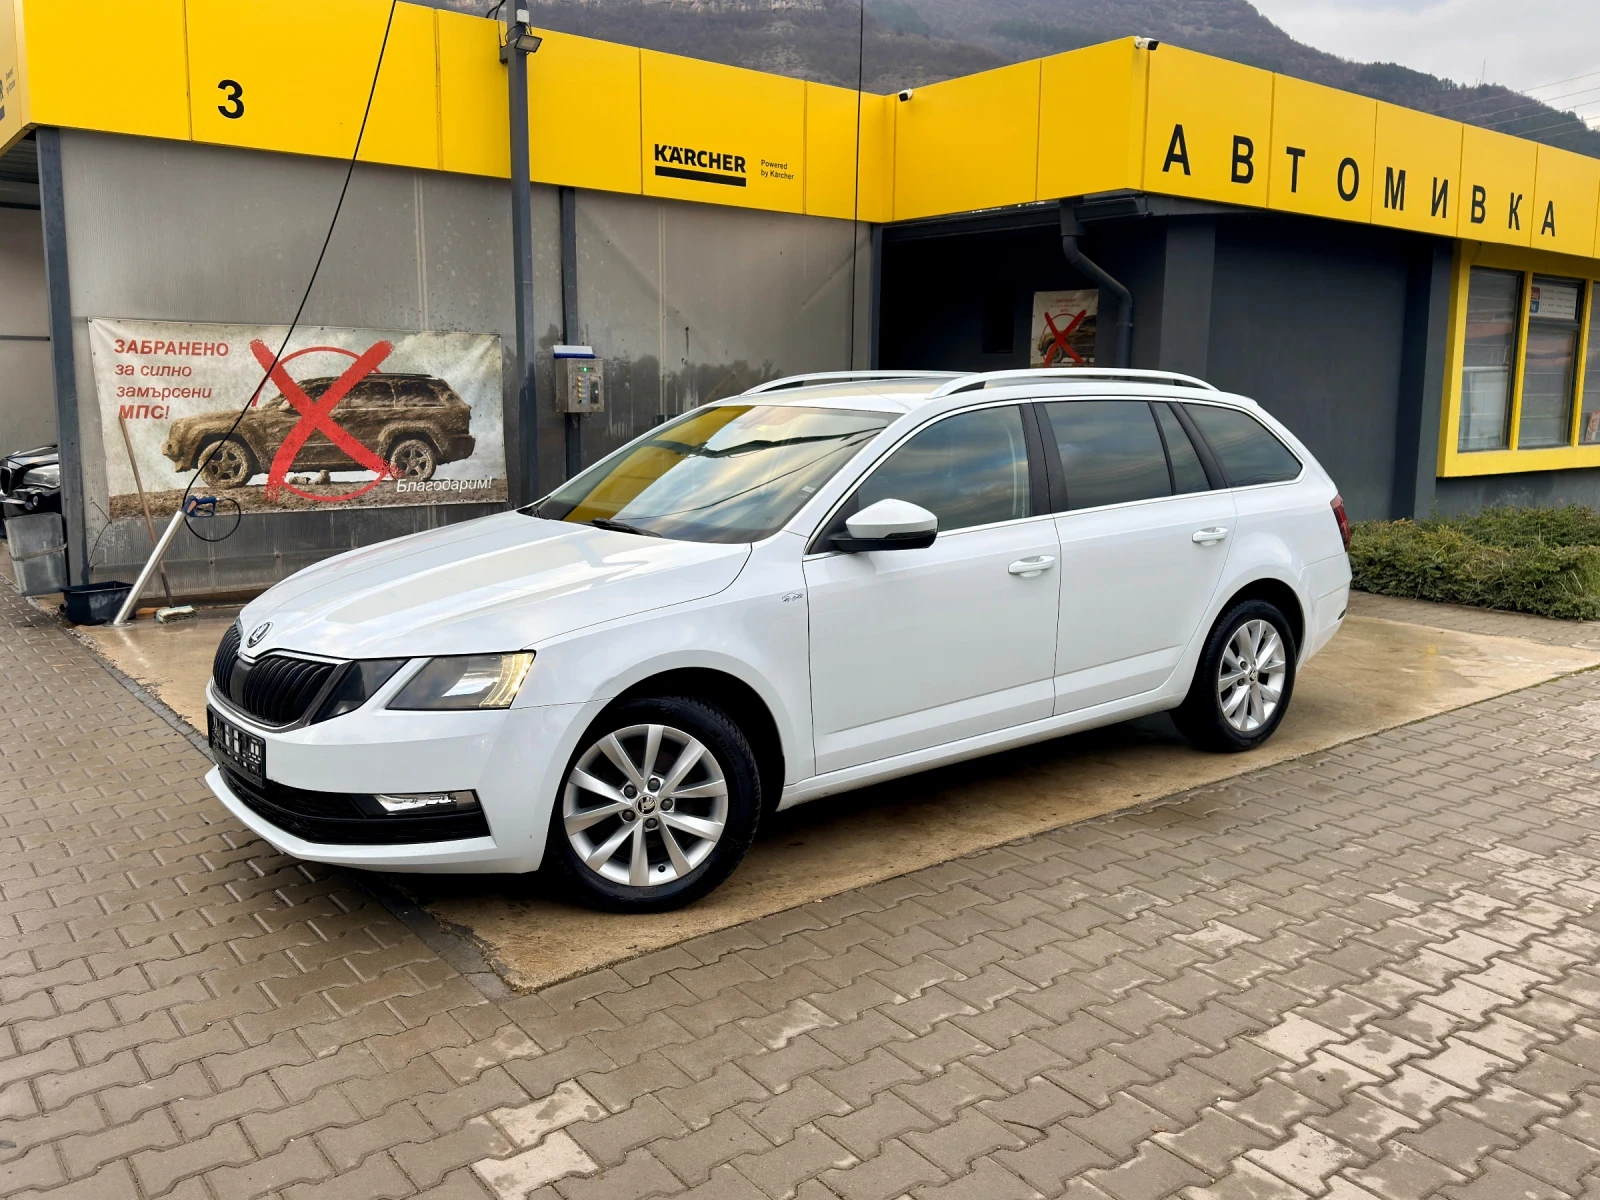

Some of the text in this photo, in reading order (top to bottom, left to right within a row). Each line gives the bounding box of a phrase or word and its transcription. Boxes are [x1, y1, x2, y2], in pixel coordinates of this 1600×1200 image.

[217, 79, 245, 119] 3
[654, 143, 747, 173] KÄRCHER
[760, 159, 788, 170] Powered
[760, 169, 769, 178] by
[1162, 123, 1556, 238] АВТОМИВКА
[114, 339, 229, 356] ЗАБРАНЕНО
[114, 364, 192, 377] за силно
[116, 386, 212, 401] замърсени
[119, 405, 169, 419] МПС!
[396, 476, 493, 493] Благодарим!
